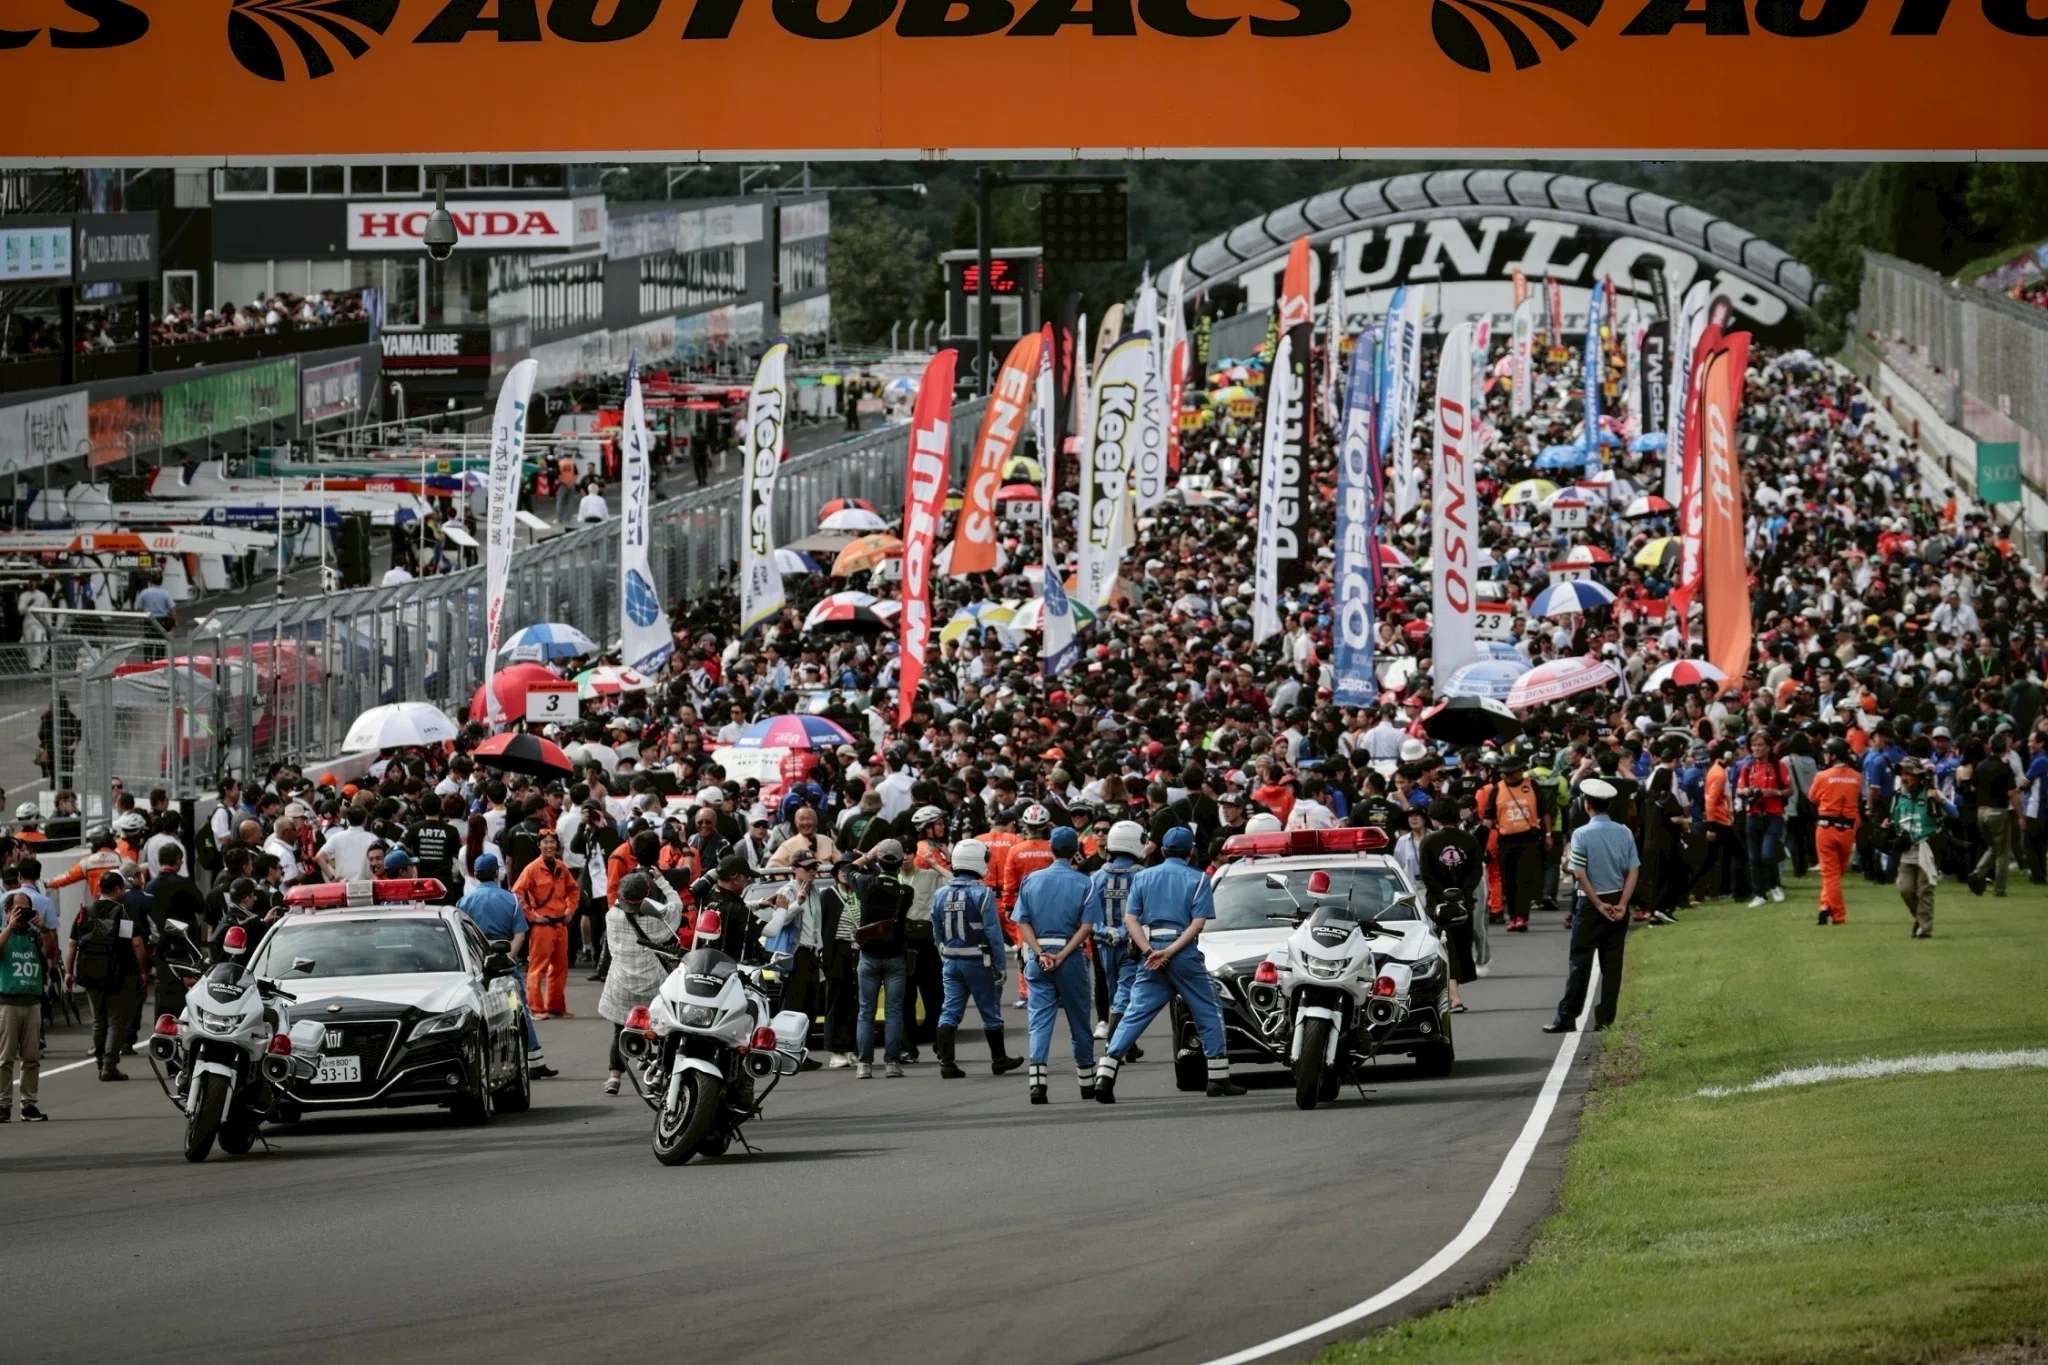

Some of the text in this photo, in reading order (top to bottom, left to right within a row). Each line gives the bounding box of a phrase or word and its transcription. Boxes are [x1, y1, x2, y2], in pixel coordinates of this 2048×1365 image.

[381, 334, 460, 356] YAMALUBE
[964, 367, 1029, 545] ENEOS
[751, 387, 782, 556] KeePer
[1088, 381, 1138, 550] KeePer
[365, 482, 395, 492] ENEOS
[1013, 503, 1034, 513] 64
[1440, 396, 1470, 614] DENSO
[1559, 510, 1578, 521] 19
[1341, 407, 1370, 650] KOBELCO
[906, 418, 949, 664] MOTUL
[116, 556, 138, 566] LEON
[1475, 614, 1500, 629] 23
[1562, 675, 1593, 690] DENSO
[1525, 686, 1557, 699] DENSO
[545, 694, 560, 711] 3
[1828, 776, 1858, 784] OFFICIAL
[418, 828, 447, 838] ARTA
[1104, 889, 1128, 898] POLICE
[1312, 926, 1348, 937] POLICE
[12, 961, 40, 978] 207
[685, 973, 723, 985] POLICE
[208, 982, 244, 994] POLICE
[212, 987, 238, 996] HONDA
[336, 1058, 349, 1067] 800
[320, 1067, 358, 1082] 93-13
